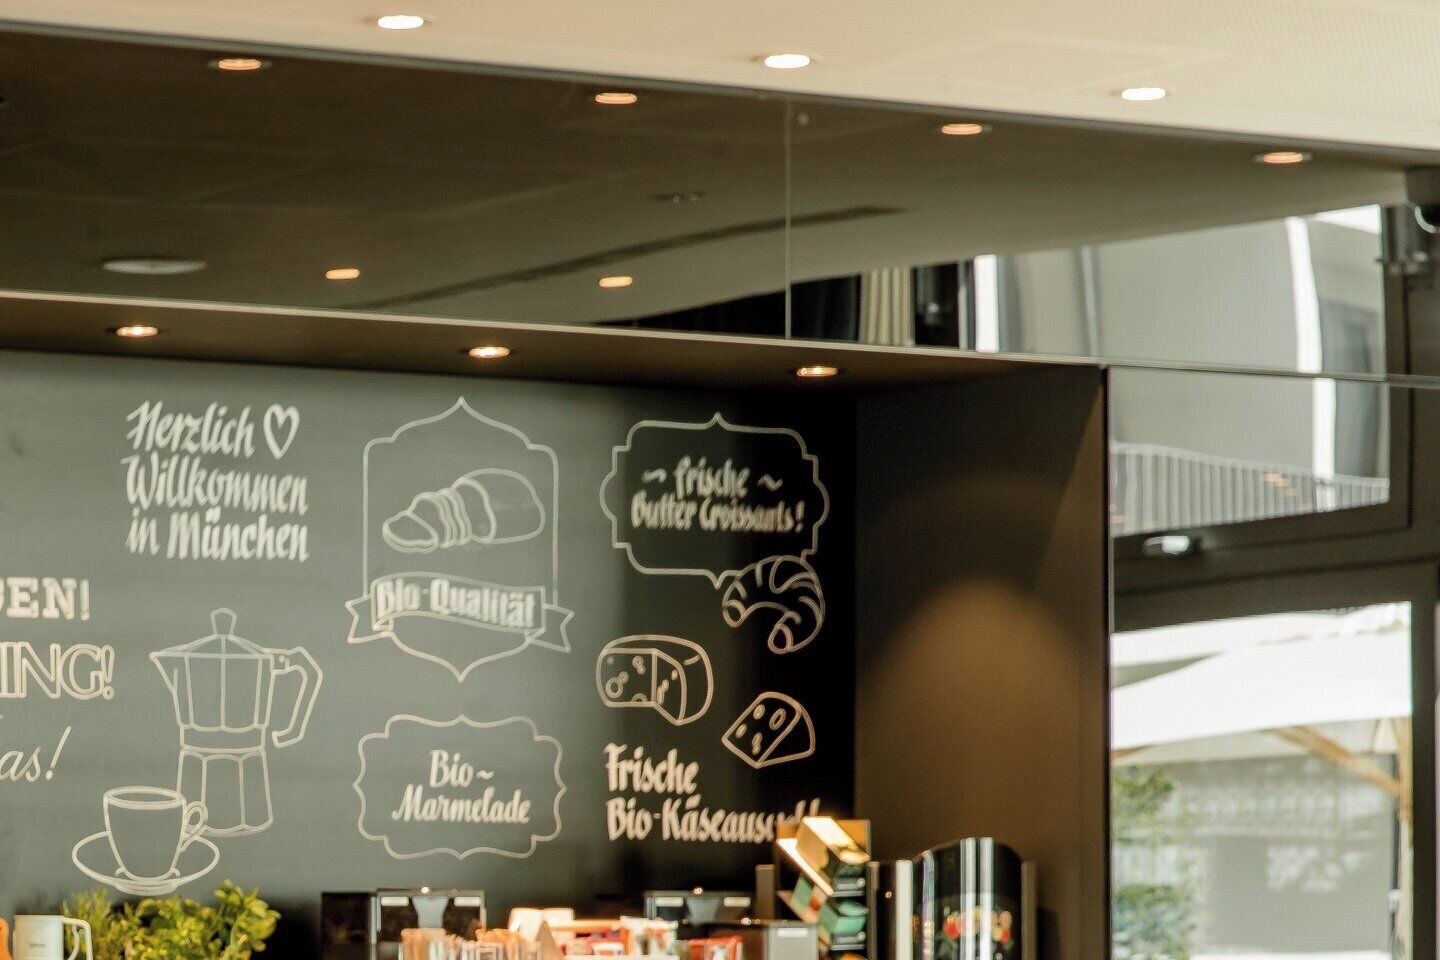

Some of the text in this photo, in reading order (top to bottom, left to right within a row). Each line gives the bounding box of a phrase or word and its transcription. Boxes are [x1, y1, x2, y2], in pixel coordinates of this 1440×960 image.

[126, 401, 255, 458] Herzlich
[120, 451, 309, 516] Willkommen
[126, 506, 310, 562] in München
[377, 578, 535, 628] Bio-Qualität
[603, 743, 699, 794] Frische
[391, 783, 531, 824] Marmelade
